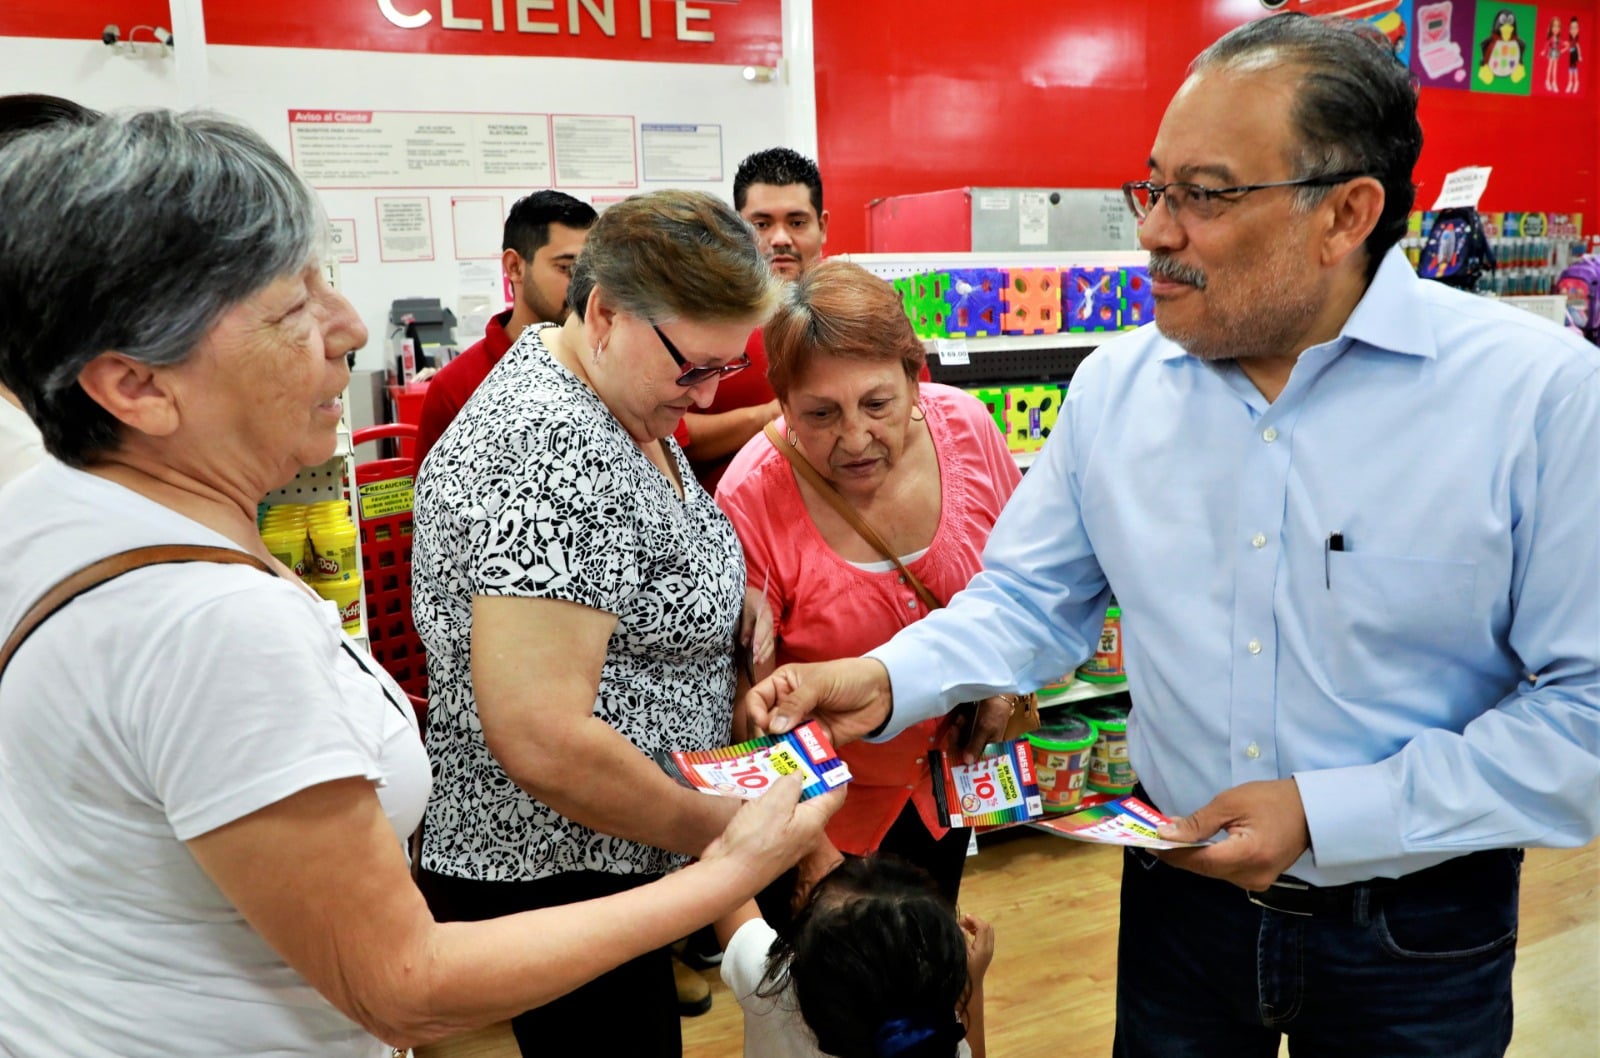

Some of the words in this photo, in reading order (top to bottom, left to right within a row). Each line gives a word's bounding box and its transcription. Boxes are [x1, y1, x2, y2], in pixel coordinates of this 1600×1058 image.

[294, 112, 322, 121] Aviso
[323, 112, 333, 121] al
[333, 112, 369, 122] Cliente
[365, 480, 412, 492] PRECAUCION
[365, 502, 383, 510] SUBIR
[374, 504, 410, 514] CANASTILLA
[779, 751, 790, 761] EN
